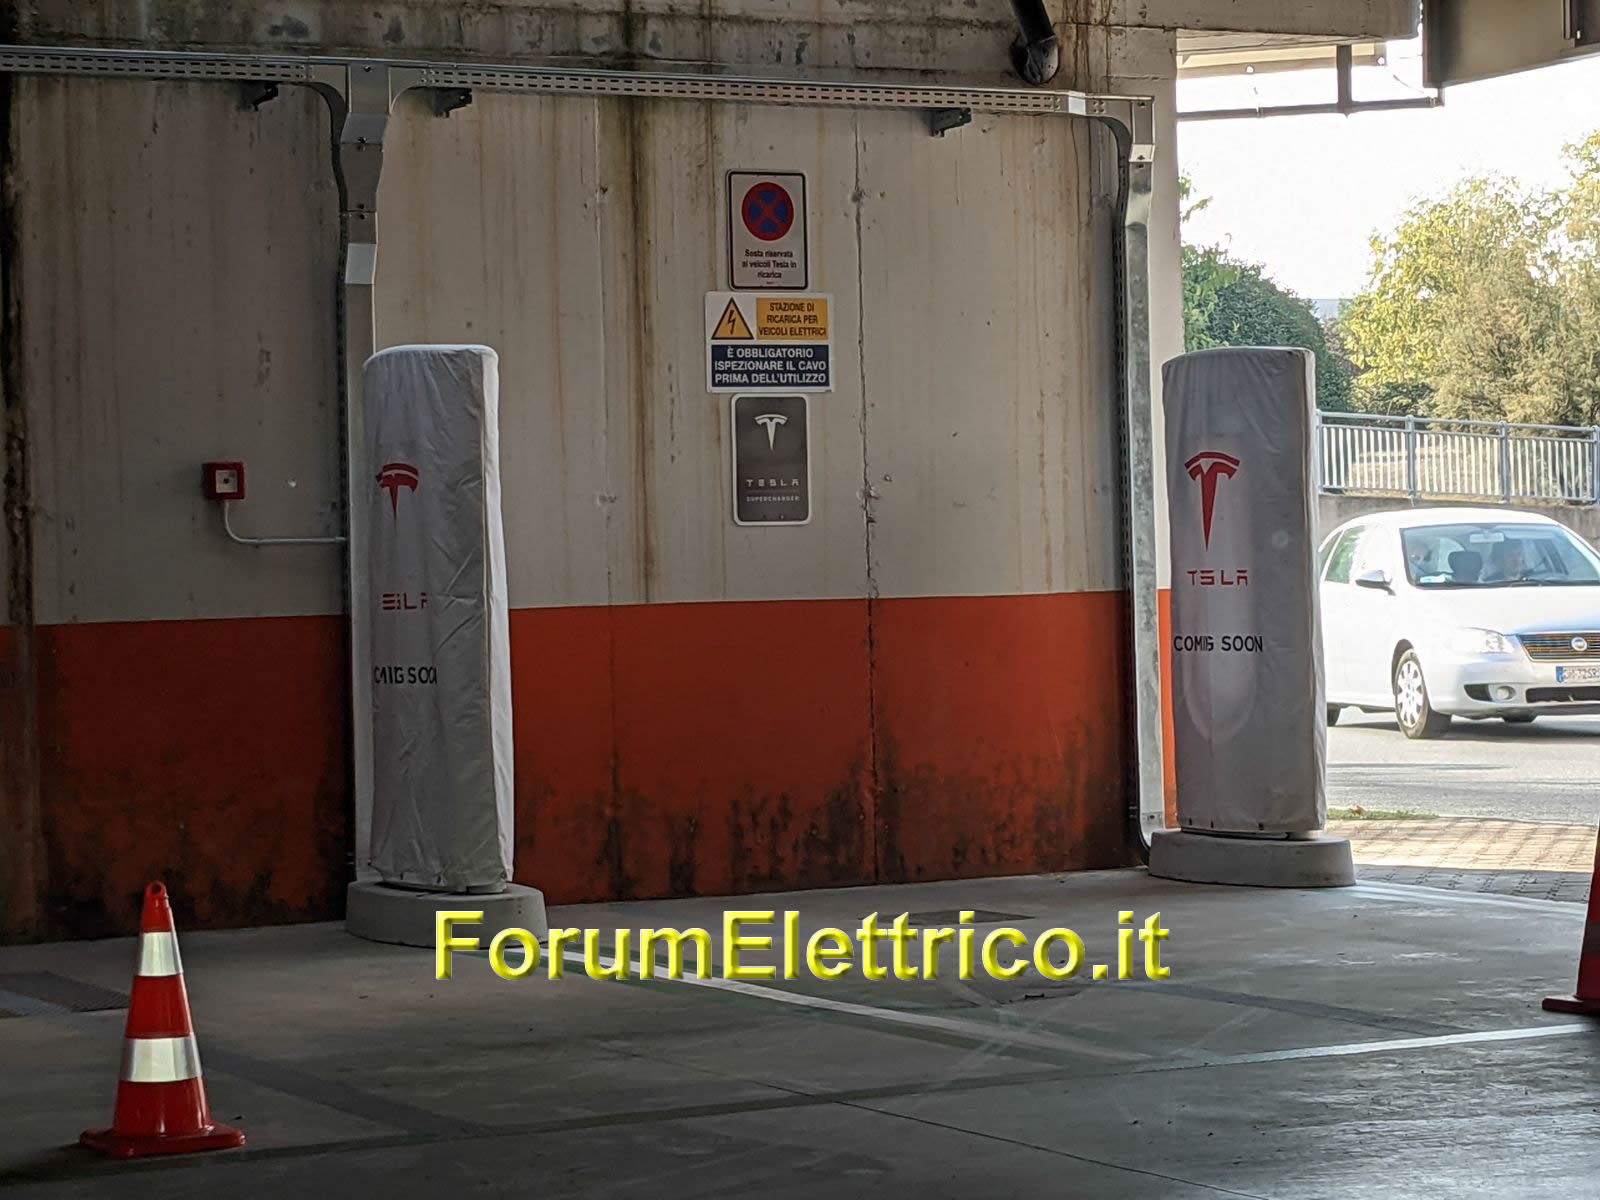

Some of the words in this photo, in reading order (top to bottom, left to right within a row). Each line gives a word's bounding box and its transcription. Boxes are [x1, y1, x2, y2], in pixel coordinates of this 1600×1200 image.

[745, 249, 763, 257] Sosta
[765, 249, 793, 257] riservata
[749, 260, 770, 268] veicoli
[772, 260, 789, 268] Tesla
[769, 302, 805, 312] STAZIONE
[806, 302, 815, 312] DI
[766, 314, 802, 324] RICARICA
[803, 314, 818, 324] PER
[759, 326, 788, 336] VEICOLI
[789, 327, 826, 336] ELETTRICI
[727, 345, 734, 358] È
[736, 347, 814, 358] OBBLIGATORIO
[714, 360, 784, 371] ISPEZIONARE
[786, 360, 796, 371] IL
[798, 360, 826, 371] CAVO
[715, 373, 749, 384] PRIMA
[751, 373, 826, 384] DELL'UTILIZZO
[746, 479, 800, 487] TESLA
[1221, 635, 1264, 653] SOON
